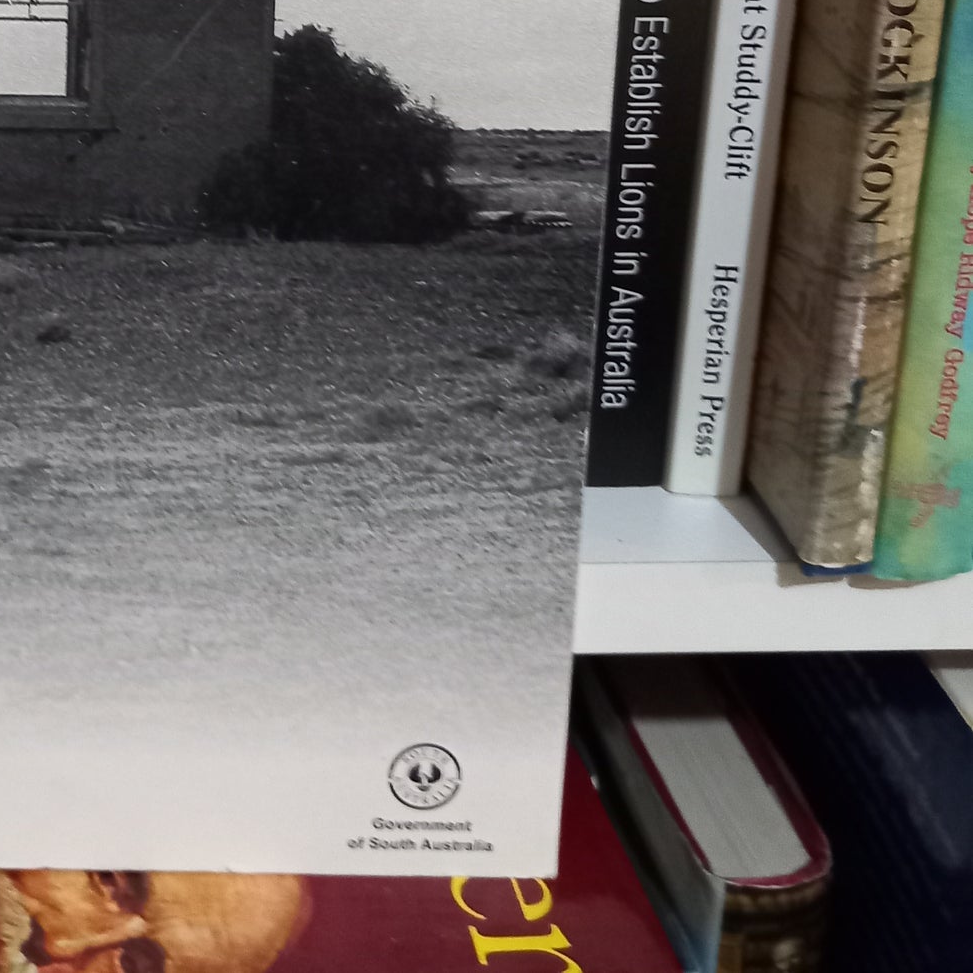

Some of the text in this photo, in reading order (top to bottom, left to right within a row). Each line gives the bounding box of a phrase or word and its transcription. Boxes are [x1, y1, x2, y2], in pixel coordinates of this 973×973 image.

[623, 16, 670, 150] Establish
[724, 25, 767, 179] Studdy-Clift
[615, 163, 656, 239] Lions
[612, 251, 648, 276] in
[600, 286, 644, 409] Australia
[693, 264, 739, 458] Hesperian Press
[929, 348, 965, 440] Godfrey
[347, 837, 494, 853] of South Australia
[372, 817, 473, 832] Government
